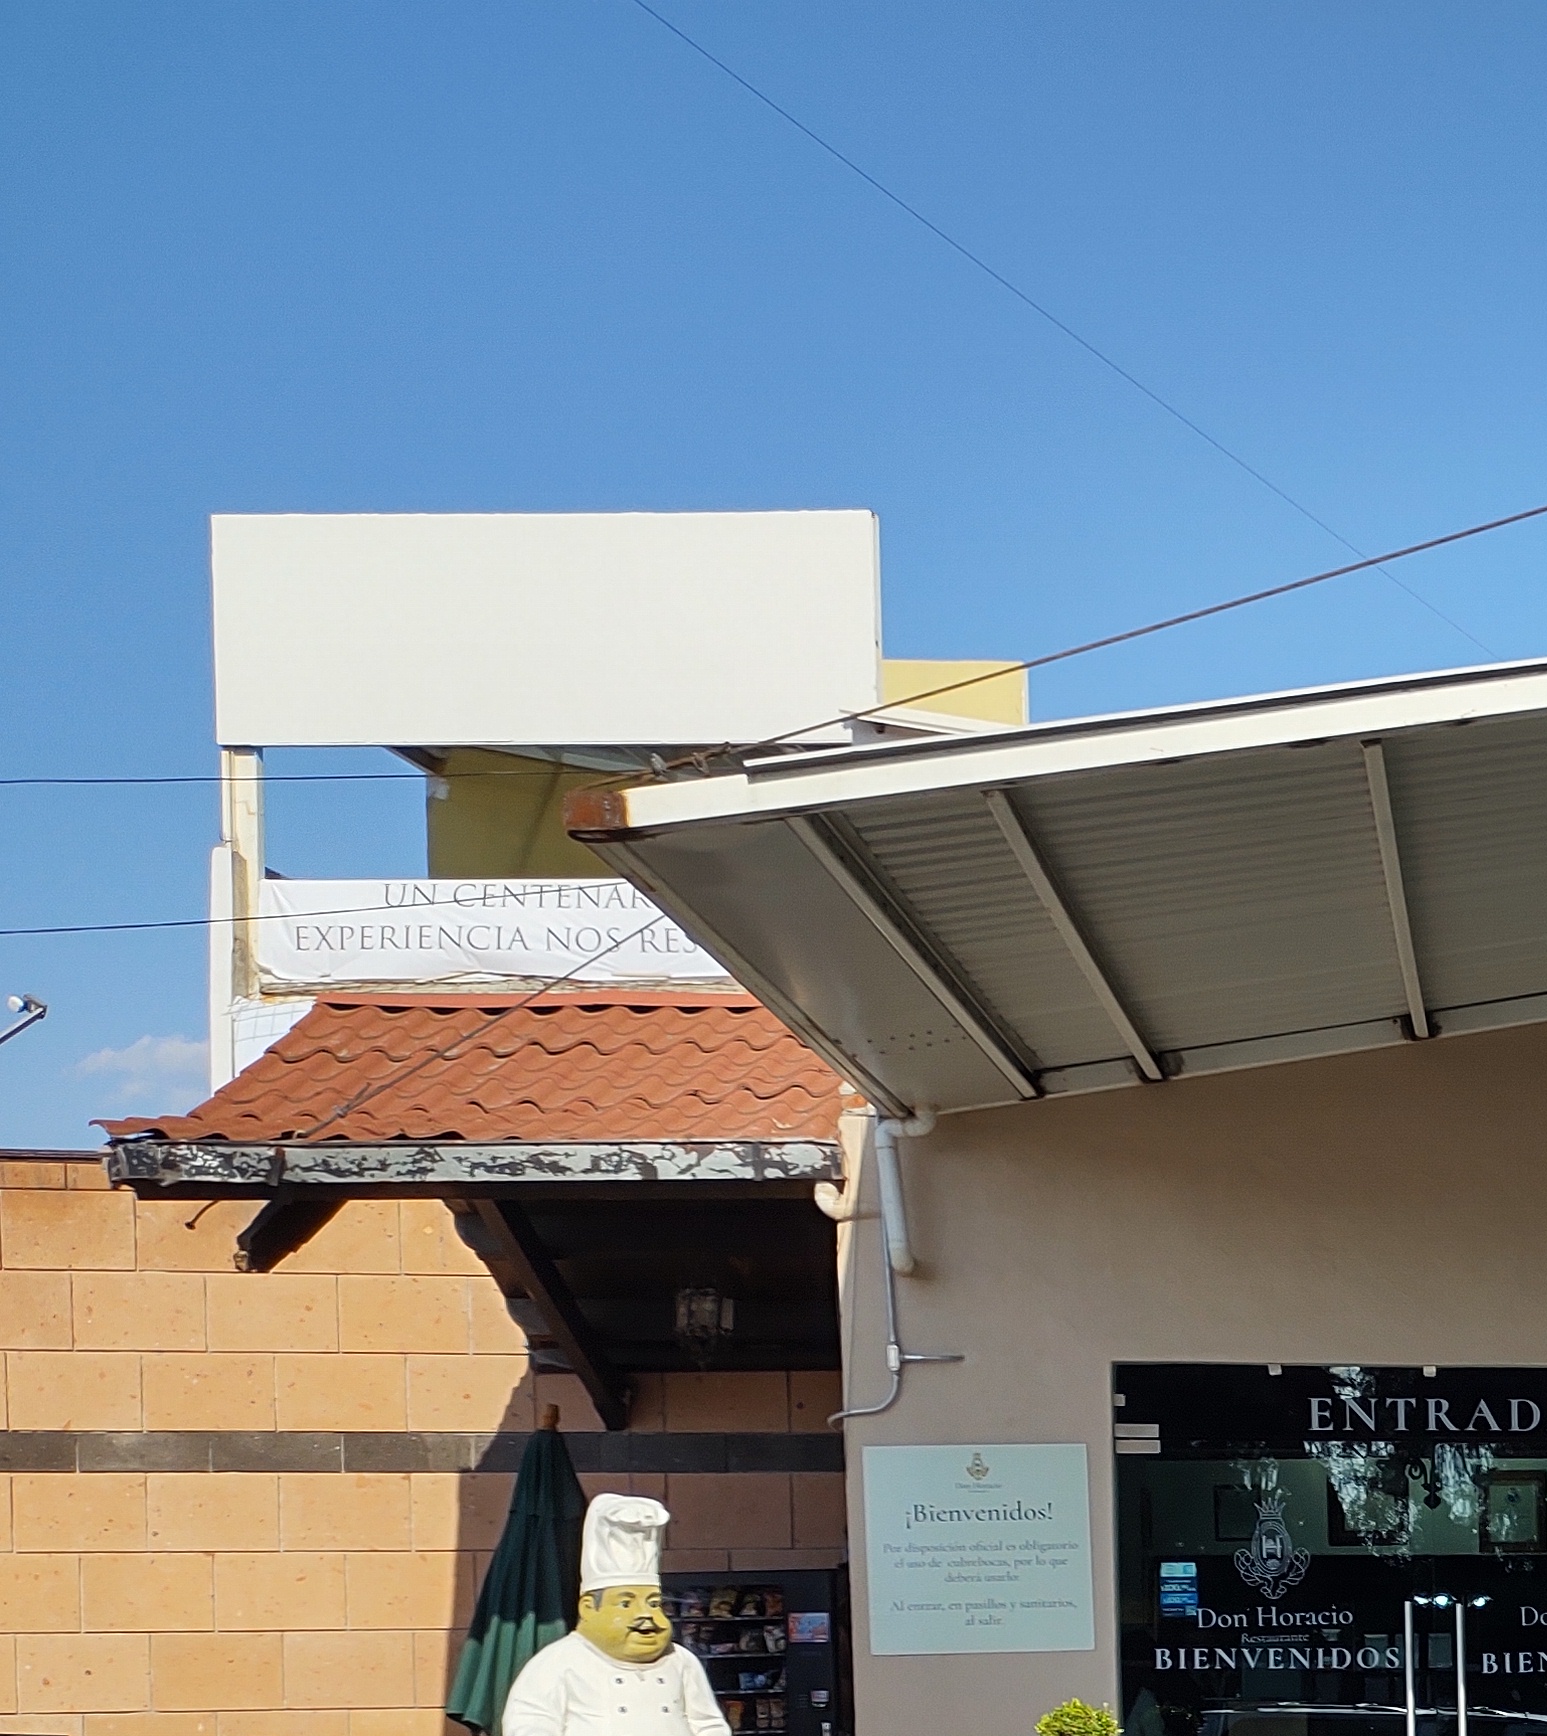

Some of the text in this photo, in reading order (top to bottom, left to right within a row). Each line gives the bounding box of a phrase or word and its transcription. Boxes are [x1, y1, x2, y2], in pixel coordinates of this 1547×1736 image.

[383, 883, 438, 909] UN
[294, 924, 532, 953] EXPERIENCIA
[546, 926, 620, 953] NOS
[905, 1500, 1053, 1530] ¡Bienvenidos!
[1019, 1539, 1079, 1554] obligatorio
[1014, 1559, 1033, 1569] por
[1035, 1554, 1047, 1566] lo
[1049, 1558, 1068, 1569] que
[1197, 1607, 1248, 1628] Don
[1256, 1604, 1354, 1627] Horacio
[1154, 1647, 1400, 1670] BIENVENIDOS
